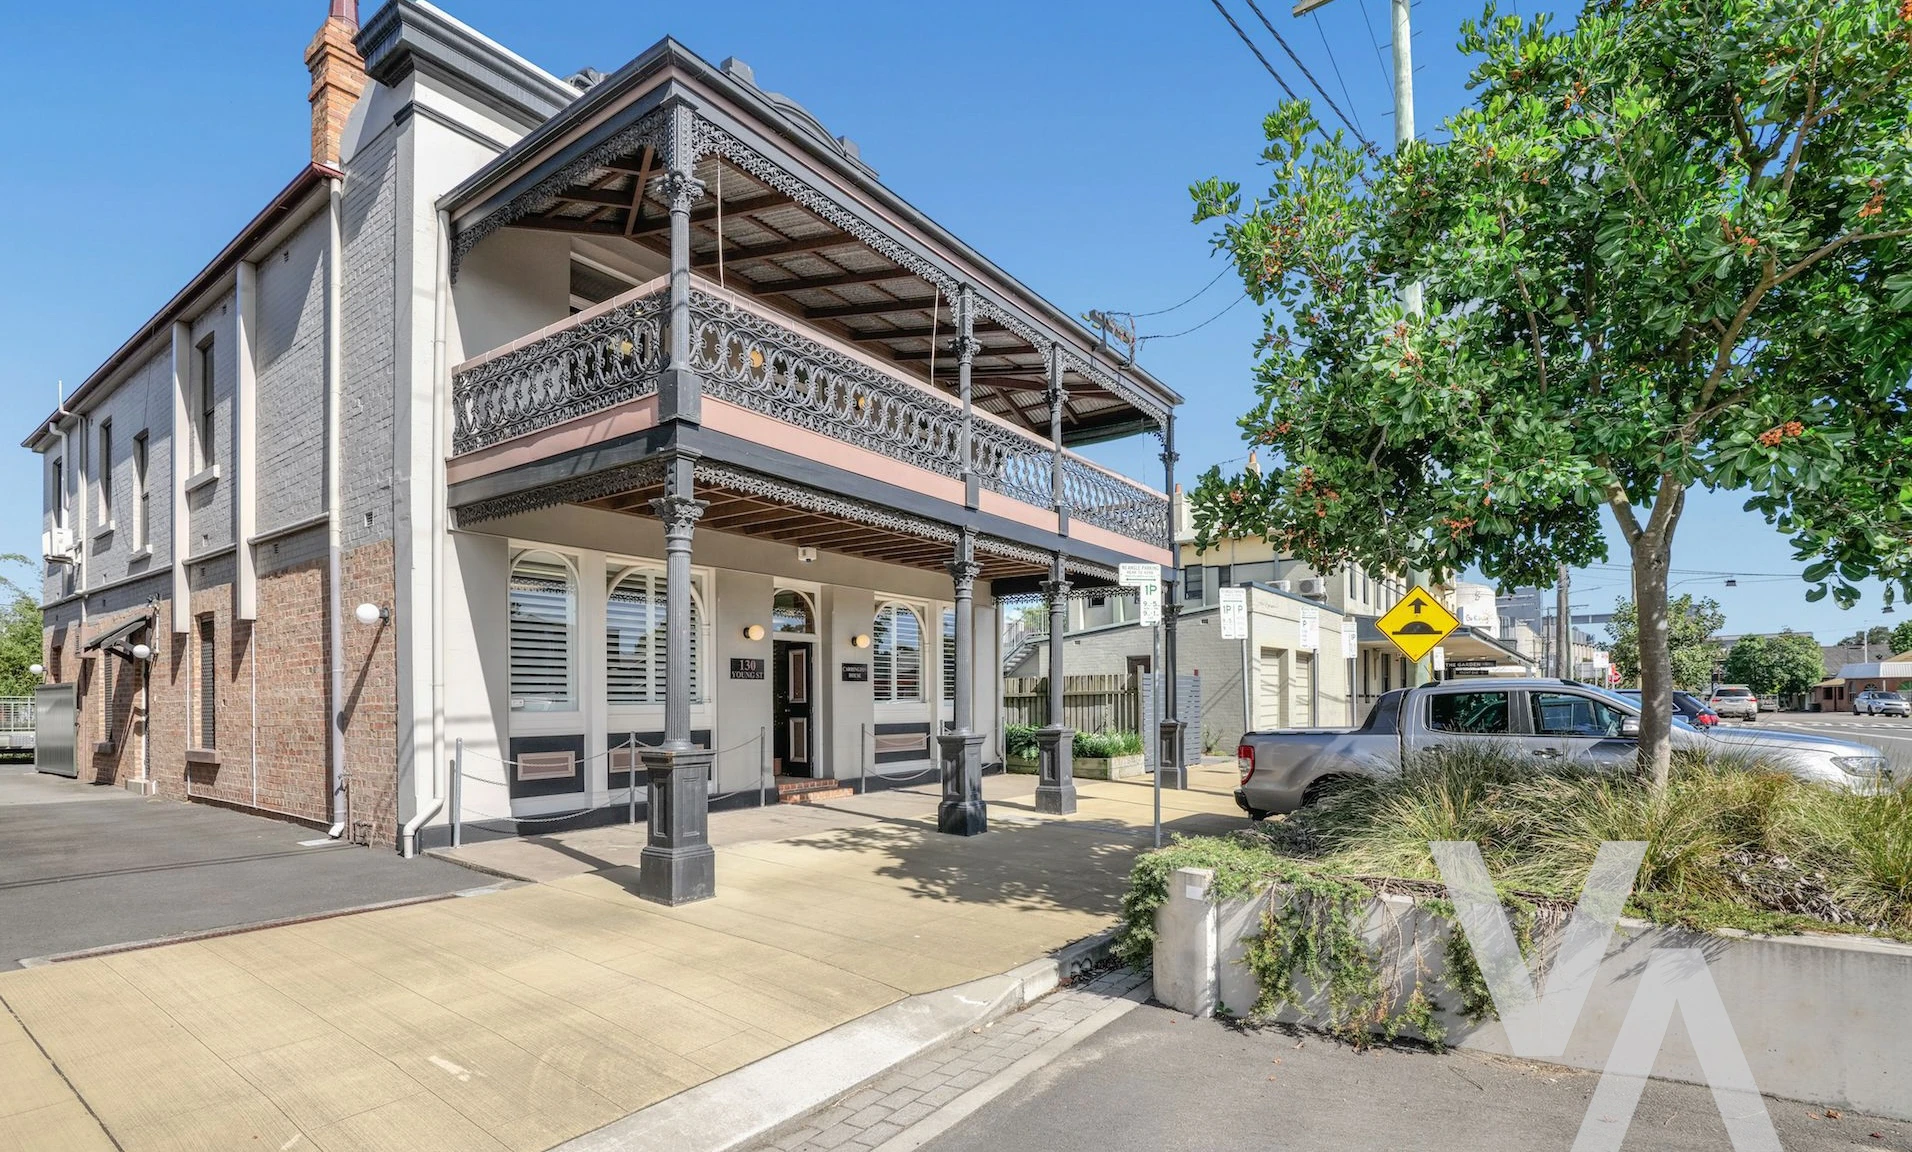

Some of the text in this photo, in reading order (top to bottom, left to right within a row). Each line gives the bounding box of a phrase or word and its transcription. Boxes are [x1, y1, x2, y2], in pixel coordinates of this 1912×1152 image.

[1145, 584, 1158, 595] 1P
[1223, 605, 1232, 614] 1P
[740, 660, 756, 670] 130
[731, 670, 763, 679] YOUNG ST
